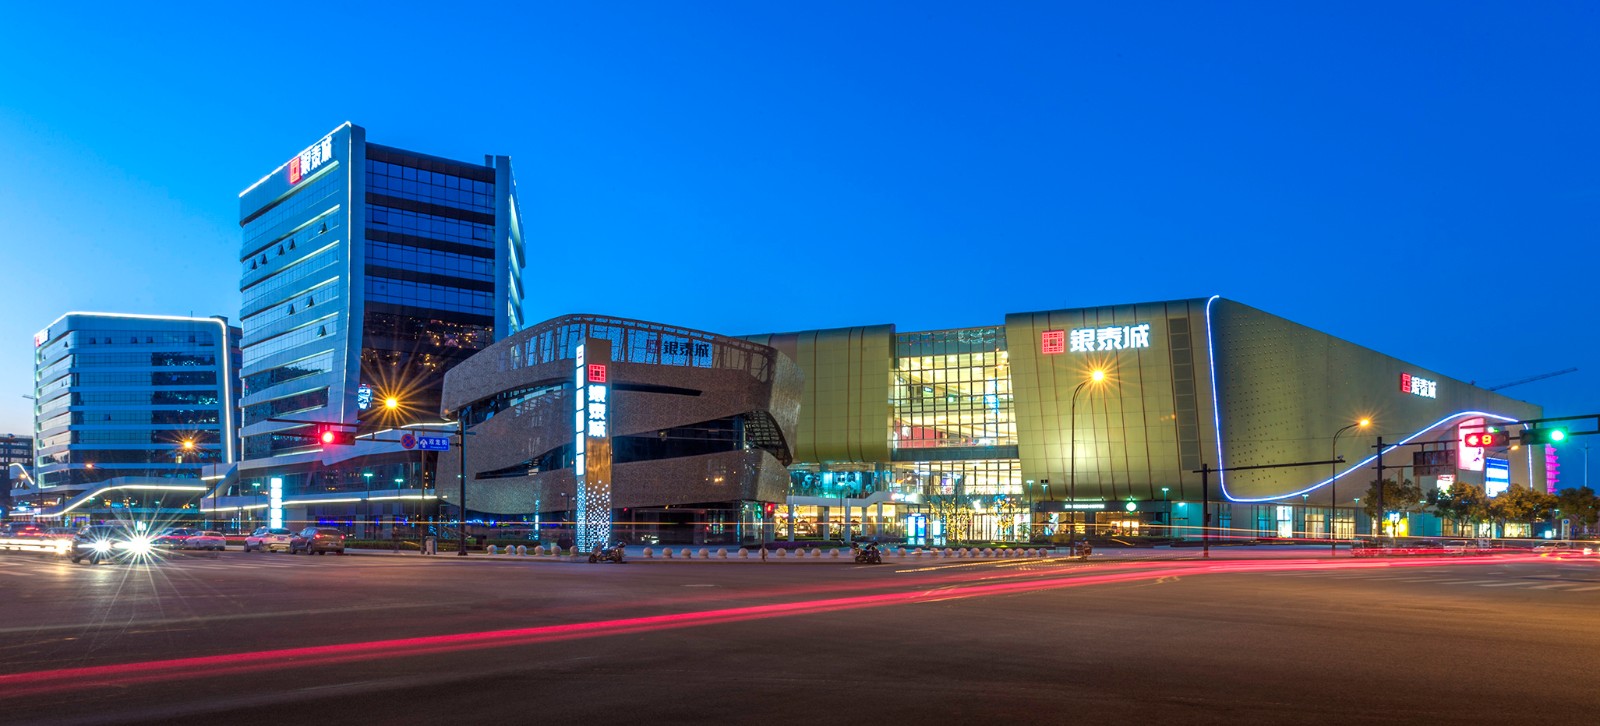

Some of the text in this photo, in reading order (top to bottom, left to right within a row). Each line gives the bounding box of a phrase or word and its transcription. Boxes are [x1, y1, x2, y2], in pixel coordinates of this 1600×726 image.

[1070, 324, 1149, 352] 银泰城
[663, 341, 710, 357] 银泰城
[1482, 435, 1492, 445] 8
